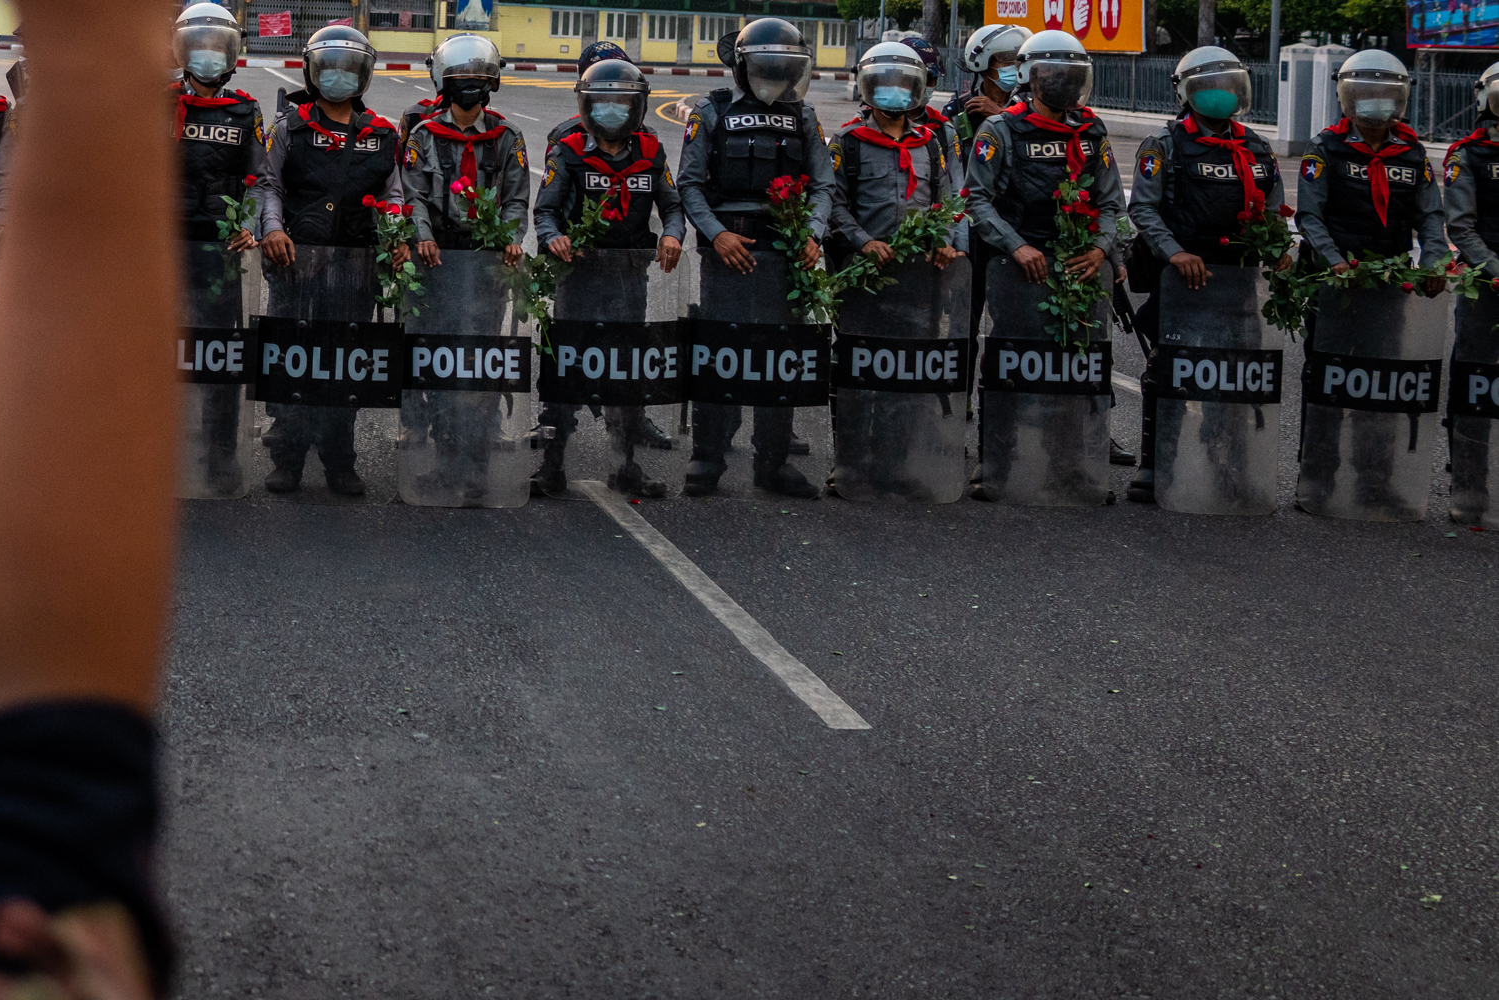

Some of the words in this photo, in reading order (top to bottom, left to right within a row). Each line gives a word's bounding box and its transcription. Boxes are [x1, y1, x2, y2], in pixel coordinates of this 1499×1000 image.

[998, 1, 1008, 14] STOP
[183, 125, 238, 143] OLICE
[729, 115, 793, 129] POLICE
[590, 175, 649, 189] POCE
[1202, 165, 1264, 178] POLE
[263, 343, 388, 381] POLICE
[413, 347, 519, 379] POLICE
[558, 346, 677, 379] POLICE
[692, 345, 817, 381] POLICE
[852, 347, 958, 380] POLICE
[999, 348, 1102, 382] POLICE
[1173, 358, 1274, 392] POLICE
[1324, 365, 1431, 401] POLICE
